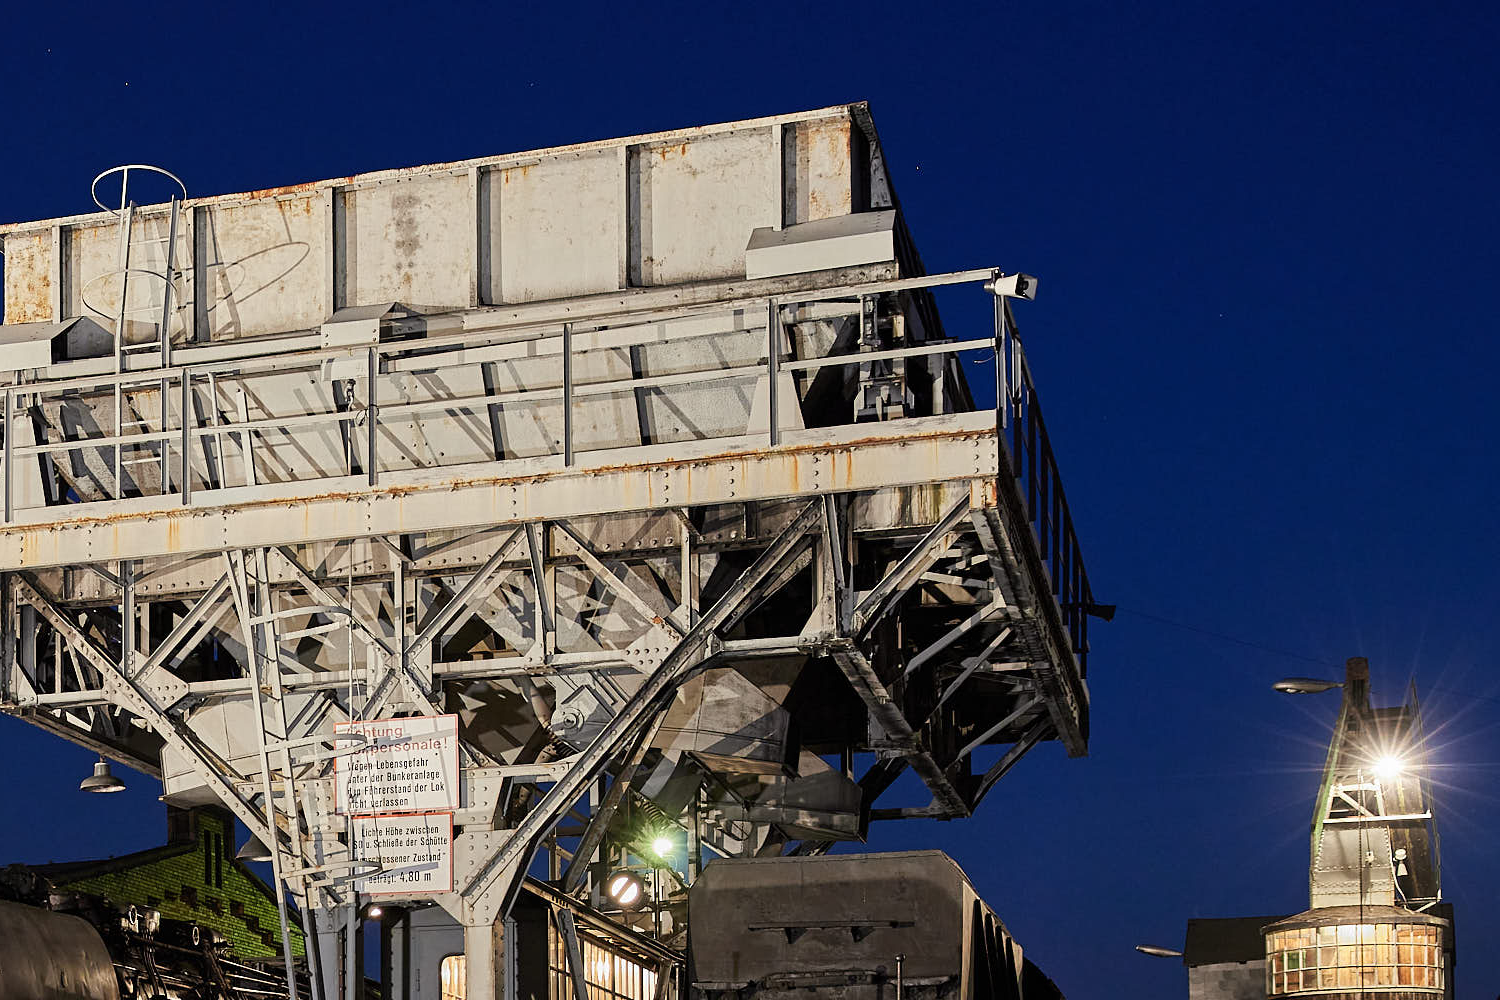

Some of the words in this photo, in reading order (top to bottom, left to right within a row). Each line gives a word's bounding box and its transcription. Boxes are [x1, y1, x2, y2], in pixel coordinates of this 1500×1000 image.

[345, 737, 448, 757] personale!
[376, 757, 429, 770] Lebensgefahr
[386, 769, 440, 782] Bunkeranlage
[414, 783, 428, 792] der
[430, 781, 445, 791] Lok
[370, 797, 408, 808] verlassen
[385, 826, 403, 836] Höhe
[405, 825, 439, 835] zwischen
[405, 838, 418, 847] der
[420, 836, 448, 846] Schütte
[424, 872, 432, 882] m
